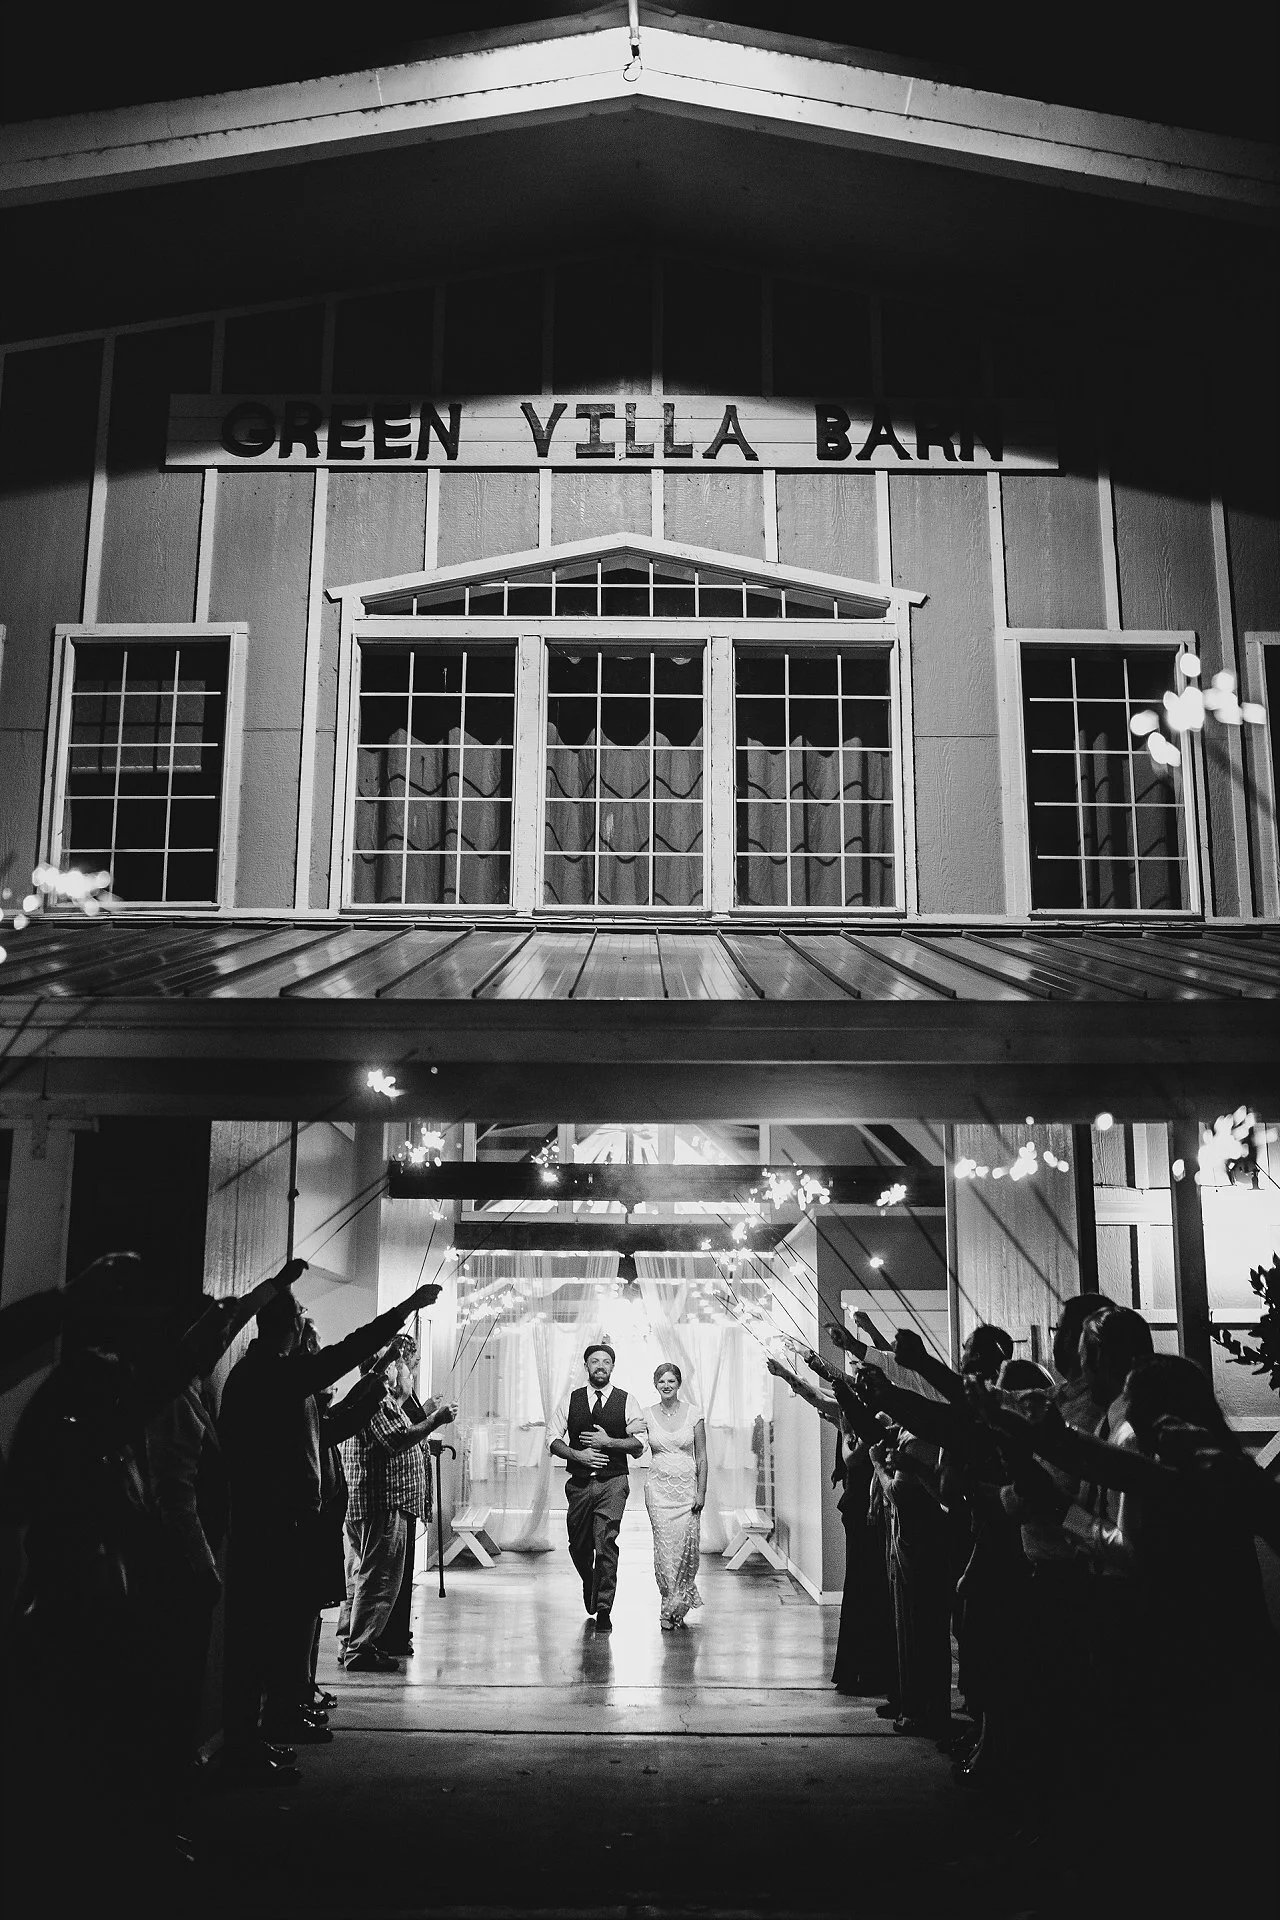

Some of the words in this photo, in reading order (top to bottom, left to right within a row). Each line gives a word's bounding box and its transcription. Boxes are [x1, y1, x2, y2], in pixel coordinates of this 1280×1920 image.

[221, 402, 463, 460] GREEN
[520, 402, 759, 461] VILLA
[815, 404, 1004, 461] BARN
